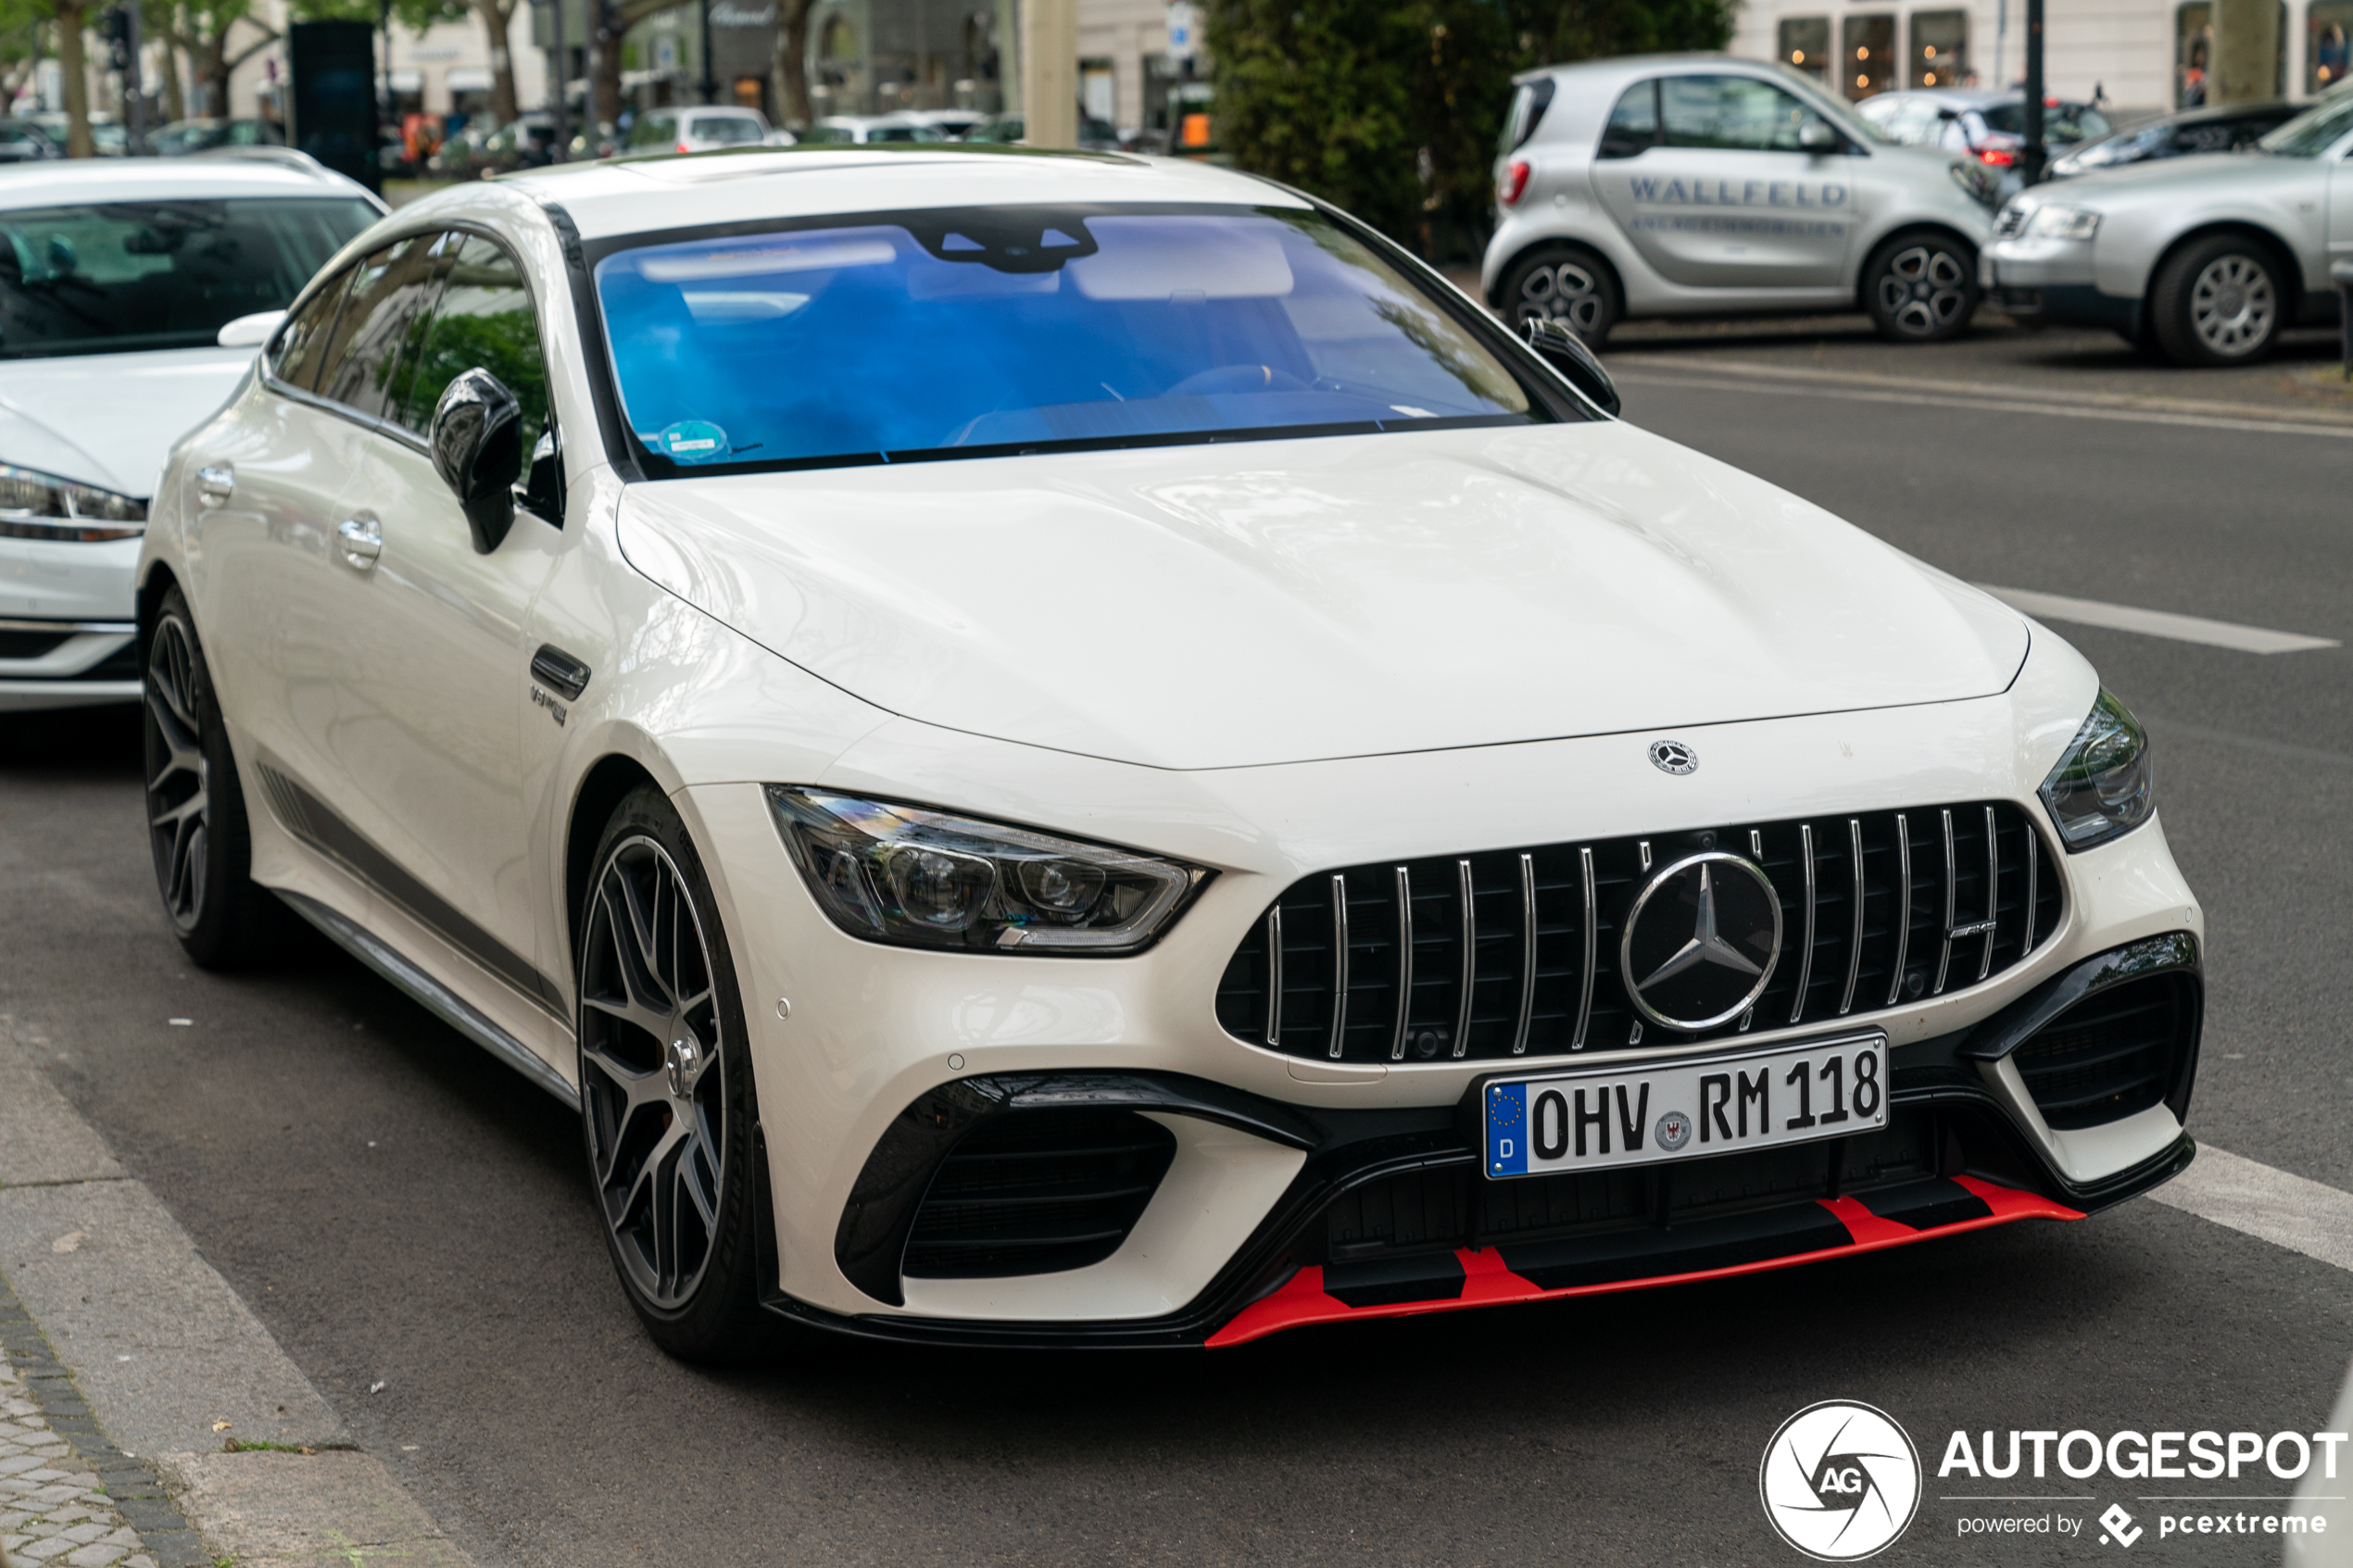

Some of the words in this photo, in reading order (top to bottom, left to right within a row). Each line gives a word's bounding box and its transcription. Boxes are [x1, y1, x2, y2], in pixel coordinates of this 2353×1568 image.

[1629, 176, 1848, 207] WALLFELD
[1532, 1081, 1650, 1160] OHV
[1699, 1067, 1769, 1143] RM
[1785, 1050, 1881, 1130] 118
[1499, 1137, 1514, 1159] D
[722, 1110, 746, 1269] MICHELIN
